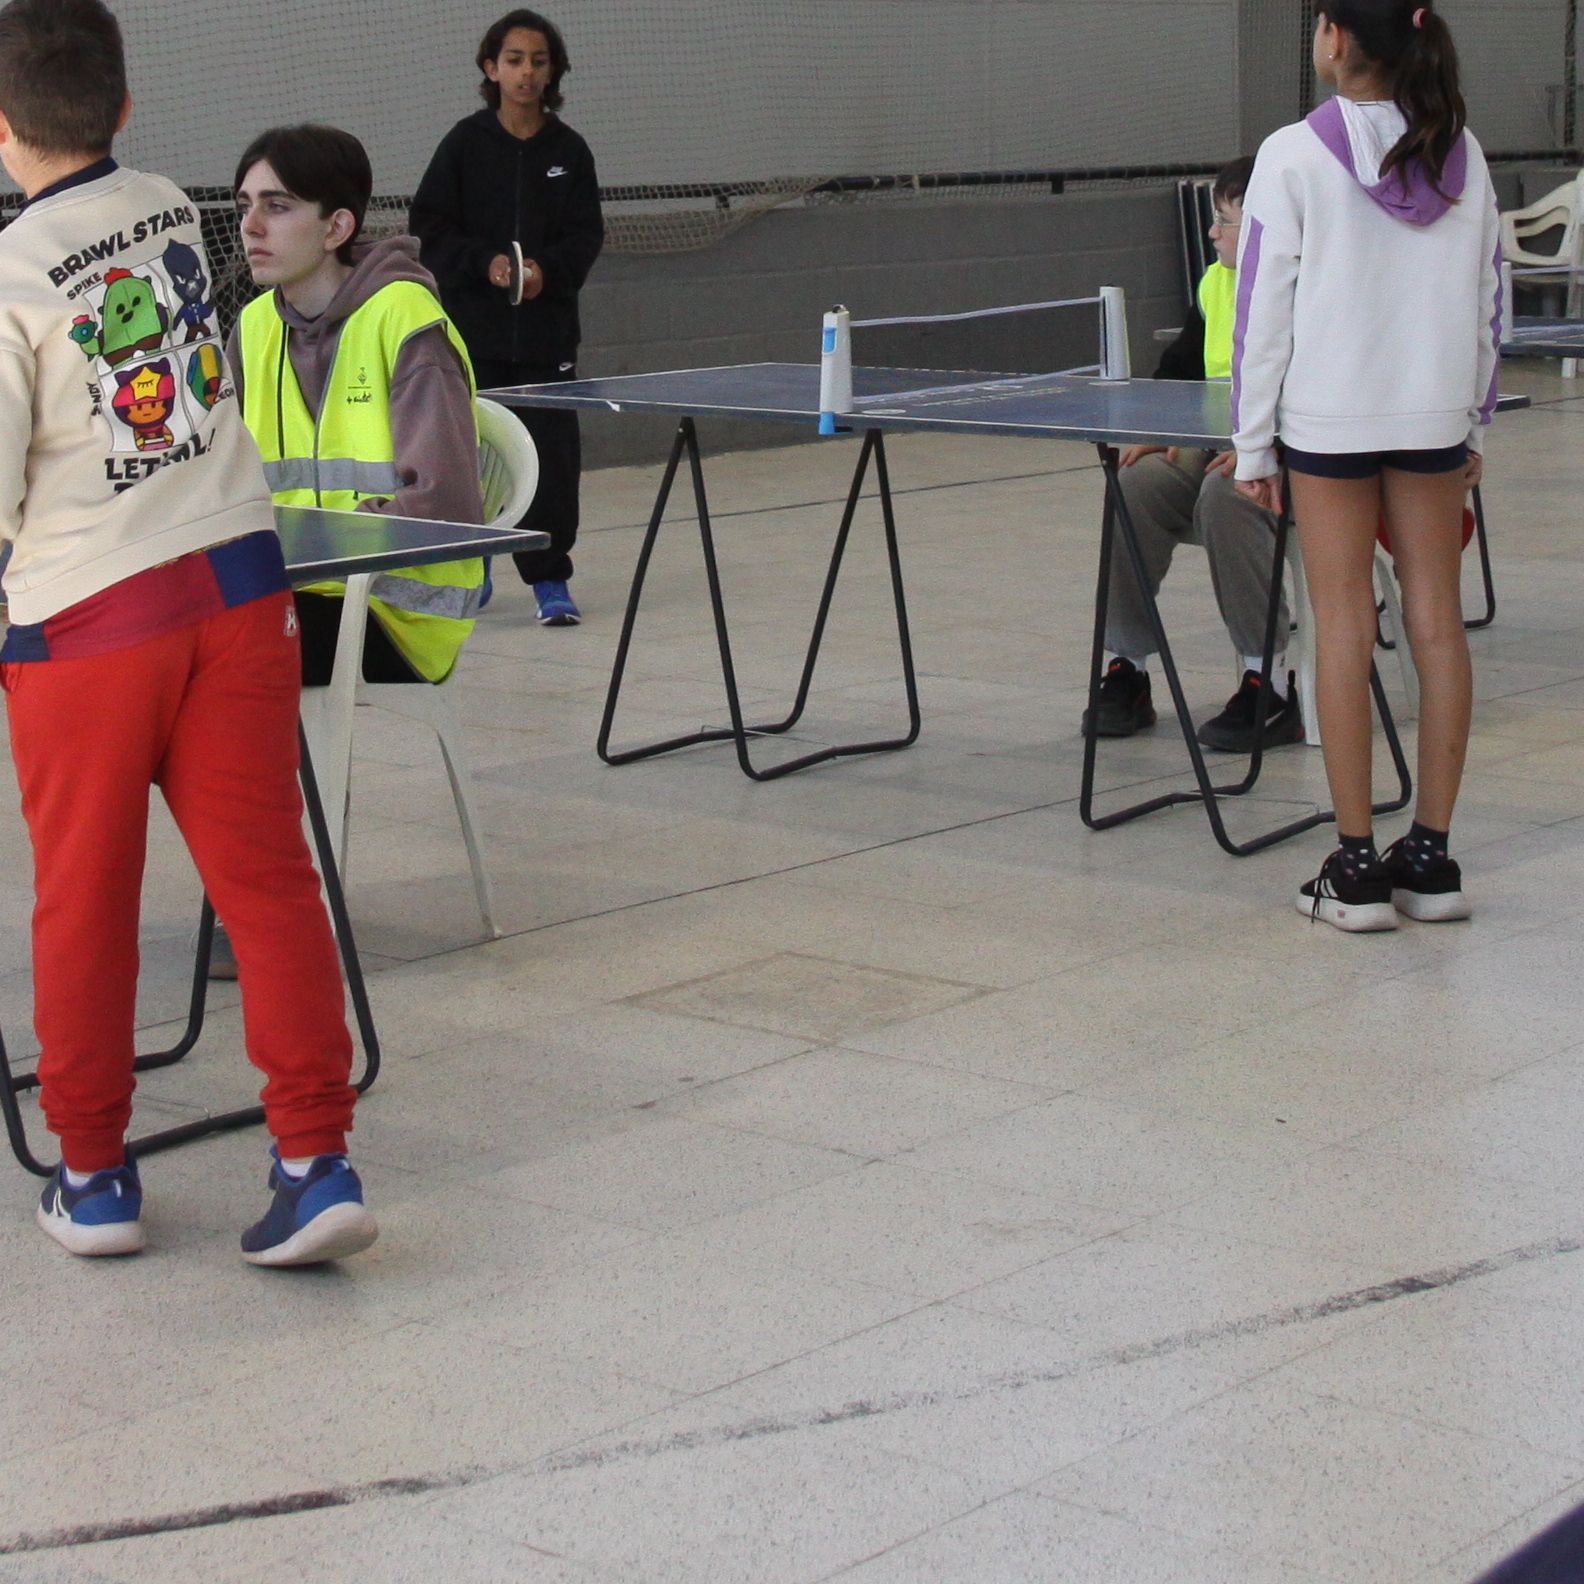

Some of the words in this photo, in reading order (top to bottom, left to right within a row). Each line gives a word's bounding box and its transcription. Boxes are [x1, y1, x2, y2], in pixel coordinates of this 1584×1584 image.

[47, 230, 131, 288] BRAWL
[133, 206, 195, 243] STARS
[66, 272, 103, 301] SPIKE
